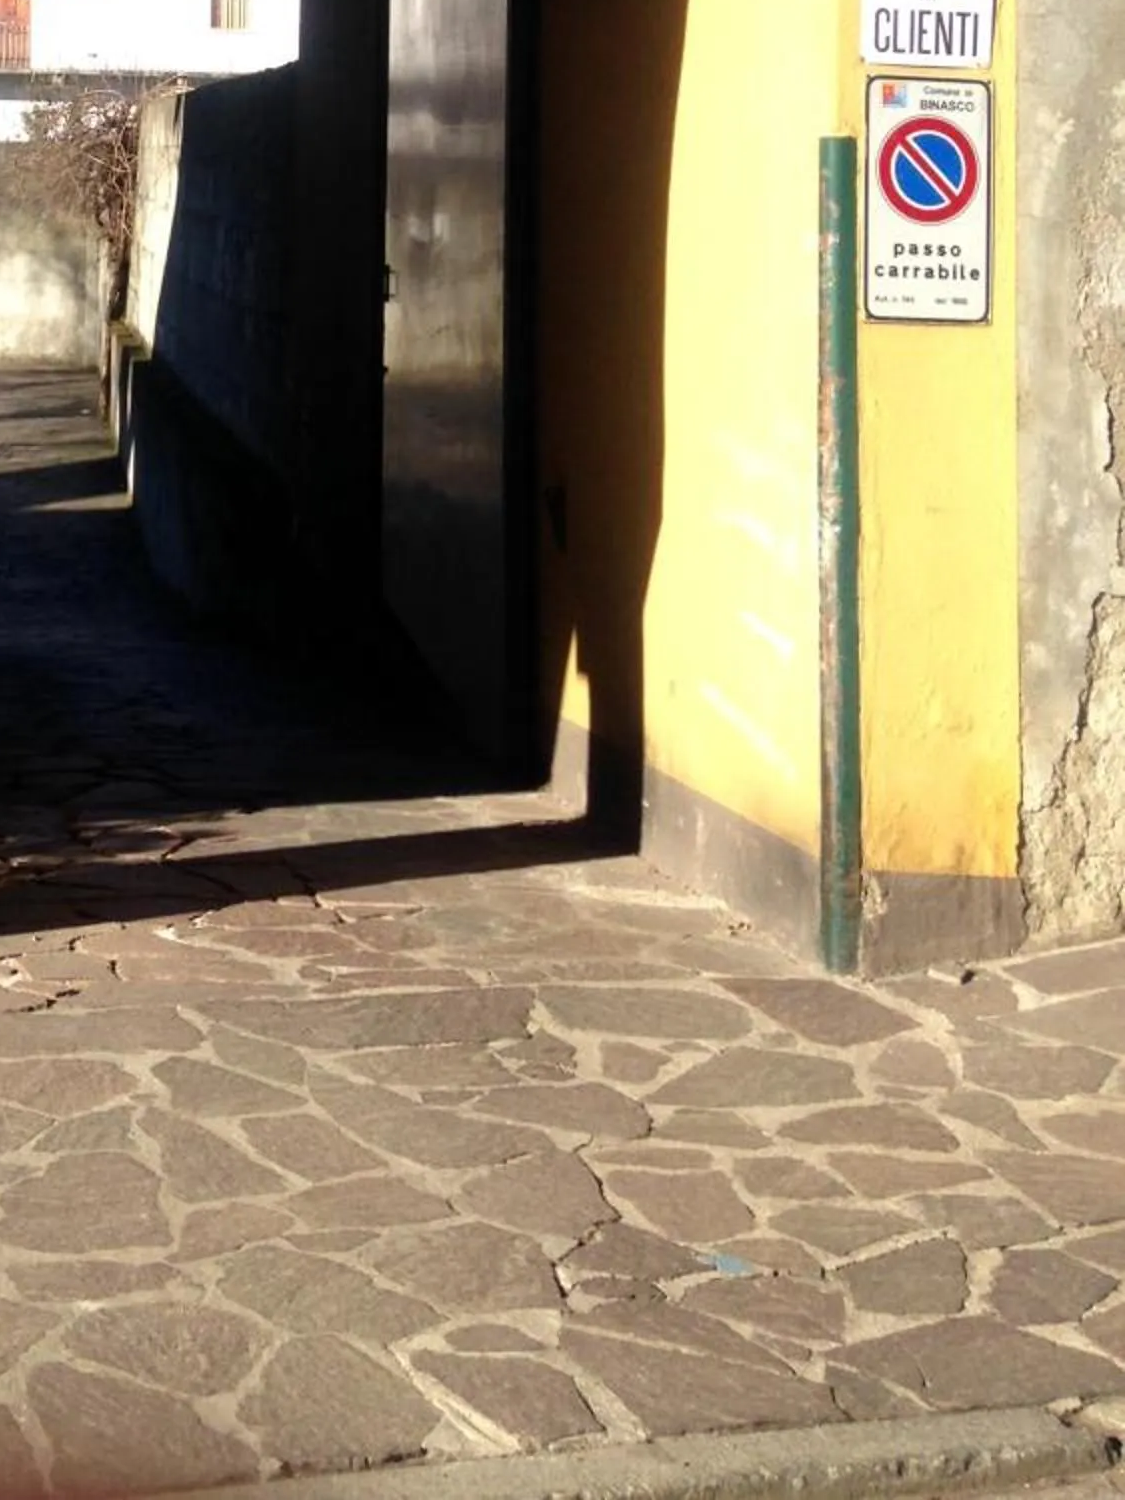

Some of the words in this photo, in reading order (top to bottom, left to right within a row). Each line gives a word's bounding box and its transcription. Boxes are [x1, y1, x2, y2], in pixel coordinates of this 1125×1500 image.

[874, 7, 979, 57] CLIENTI
[920, 99, 975, 113] BINASCO
[893, 243, 962, 259] passo
[874, 263, 980, 281] carrabile
